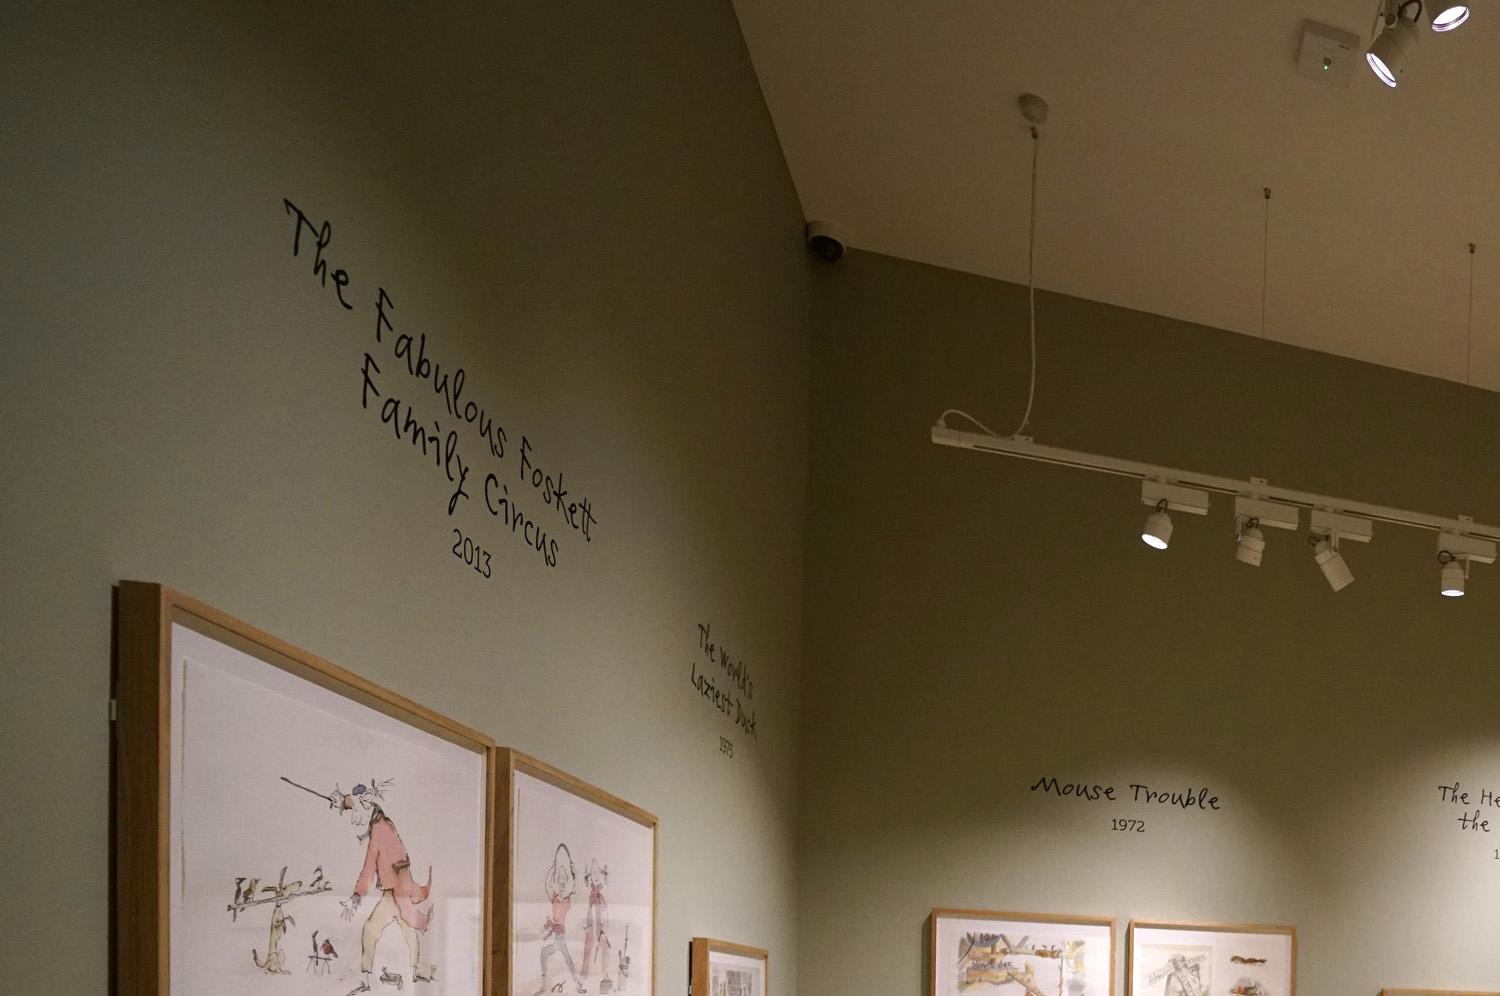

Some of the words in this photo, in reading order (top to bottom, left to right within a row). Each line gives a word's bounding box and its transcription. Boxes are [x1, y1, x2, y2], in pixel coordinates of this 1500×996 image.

[283, 198, 354, 311] The
[374, 286, 508, 459] Fabulous
[519, 435, 598, 543] Foskett
[360, 352, 470, 516] Family
[484, 472, 559, 568] Circus
[450, 528, 493, 580] 2013
[698, 623, 716, 663] The
[690, 661, 734, 717] Laziest
[734, 697, 758, 742] Duck
[1030, 776, 1118, 802] Mouse
[1128, 783, 1222, 811] Trouble
[1437, 781, 1471, 805] The
[1111, 818, 1146, 833] 1972
[1457, 809, 1490, 833] the
